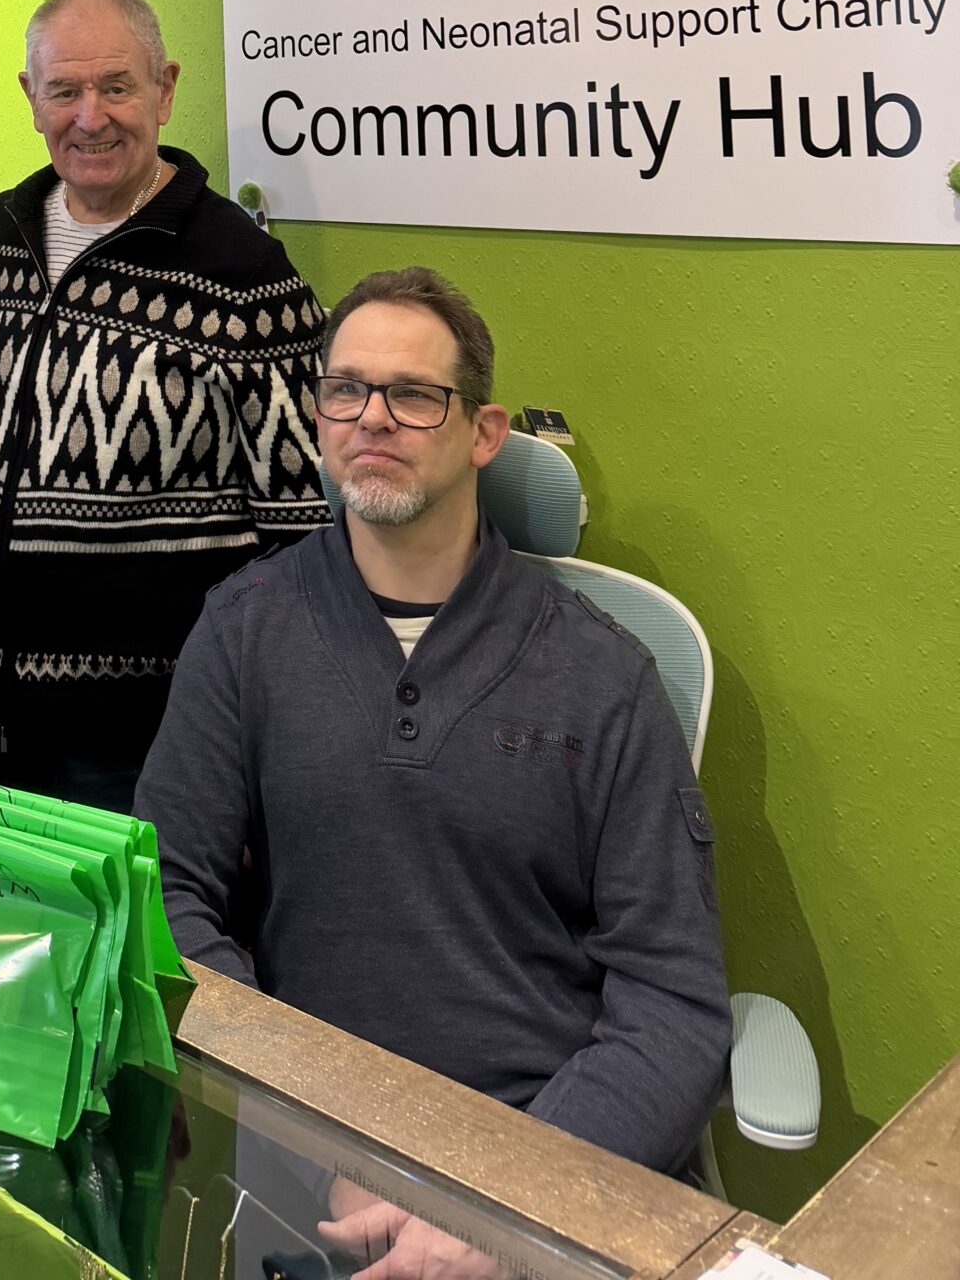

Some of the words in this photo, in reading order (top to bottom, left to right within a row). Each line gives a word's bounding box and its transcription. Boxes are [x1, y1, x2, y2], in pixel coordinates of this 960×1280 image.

[241, 29, 343, 60] Cancer
[352, 19, 409, 55] and
[422, 7, 580, 51] Neonatal
[261, 81, 681, 180] Community
[718, 71, 922, 159] Hub
